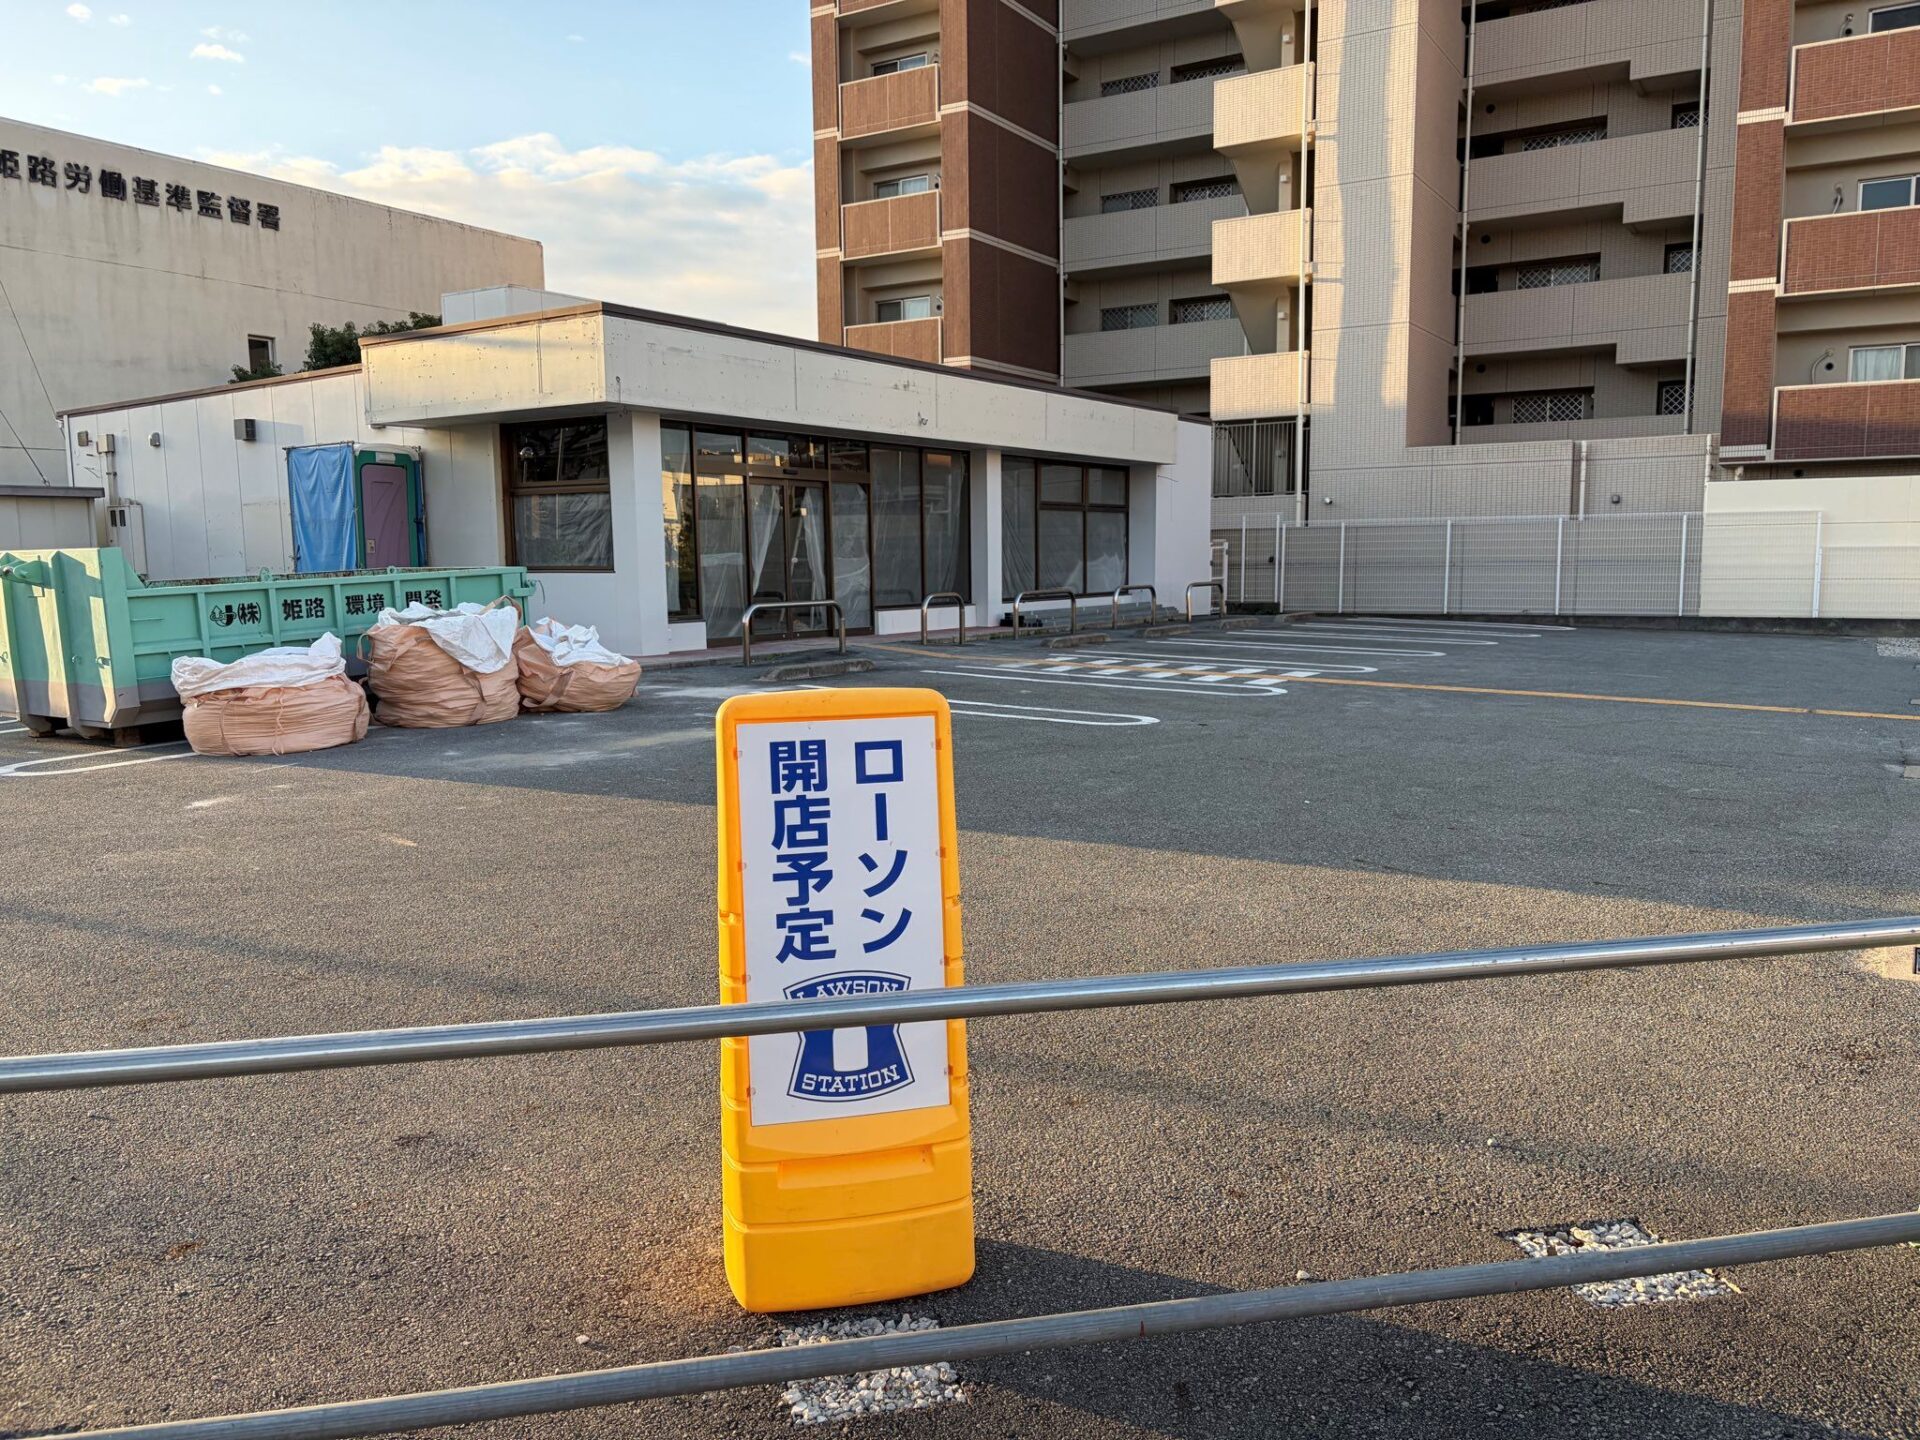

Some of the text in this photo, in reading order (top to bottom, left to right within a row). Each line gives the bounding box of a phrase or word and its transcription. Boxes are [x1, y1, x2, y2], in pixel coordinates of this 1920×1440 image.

[769, 739, 837, 963] 開店予定
[854, 739, 912, 954] ローソン
[801, 1064, 900, 1093] STATION
